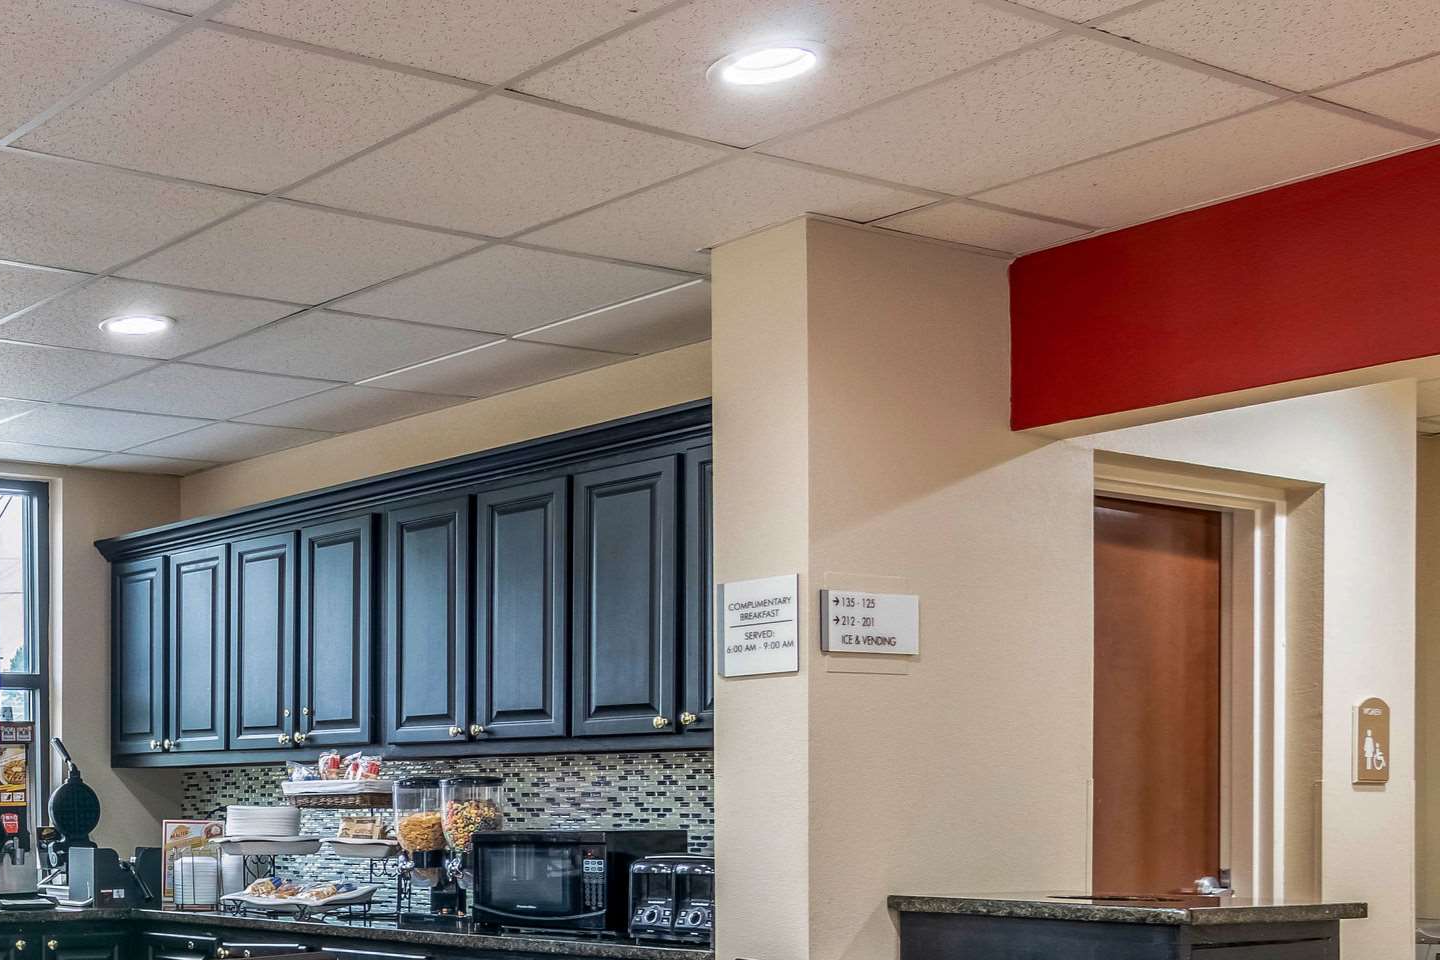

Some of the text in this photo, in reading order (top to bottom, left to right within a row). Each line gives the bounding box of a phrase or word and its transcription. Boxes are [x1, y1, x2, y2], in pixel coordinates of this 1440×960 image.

[728, 596, 792, 611] COMPLIMENTARY
[841, 597, 855, 608] 135
[862, 598, 876, 609] 125
[740, 608, 780, 621] BREAKFAST
[841, 615, 856, 627] 212
[862, 616, 875, 627] 201
[744, 629, 776, 640] SERVED:
[841, 634, 897, 647] ICE & VENDING
[726, 644, 743, 654] 6:00
[744, 644, 757, 652] AM
[763, 640, 780, 650] 9:00
[781, 640, 794, 648] AM
